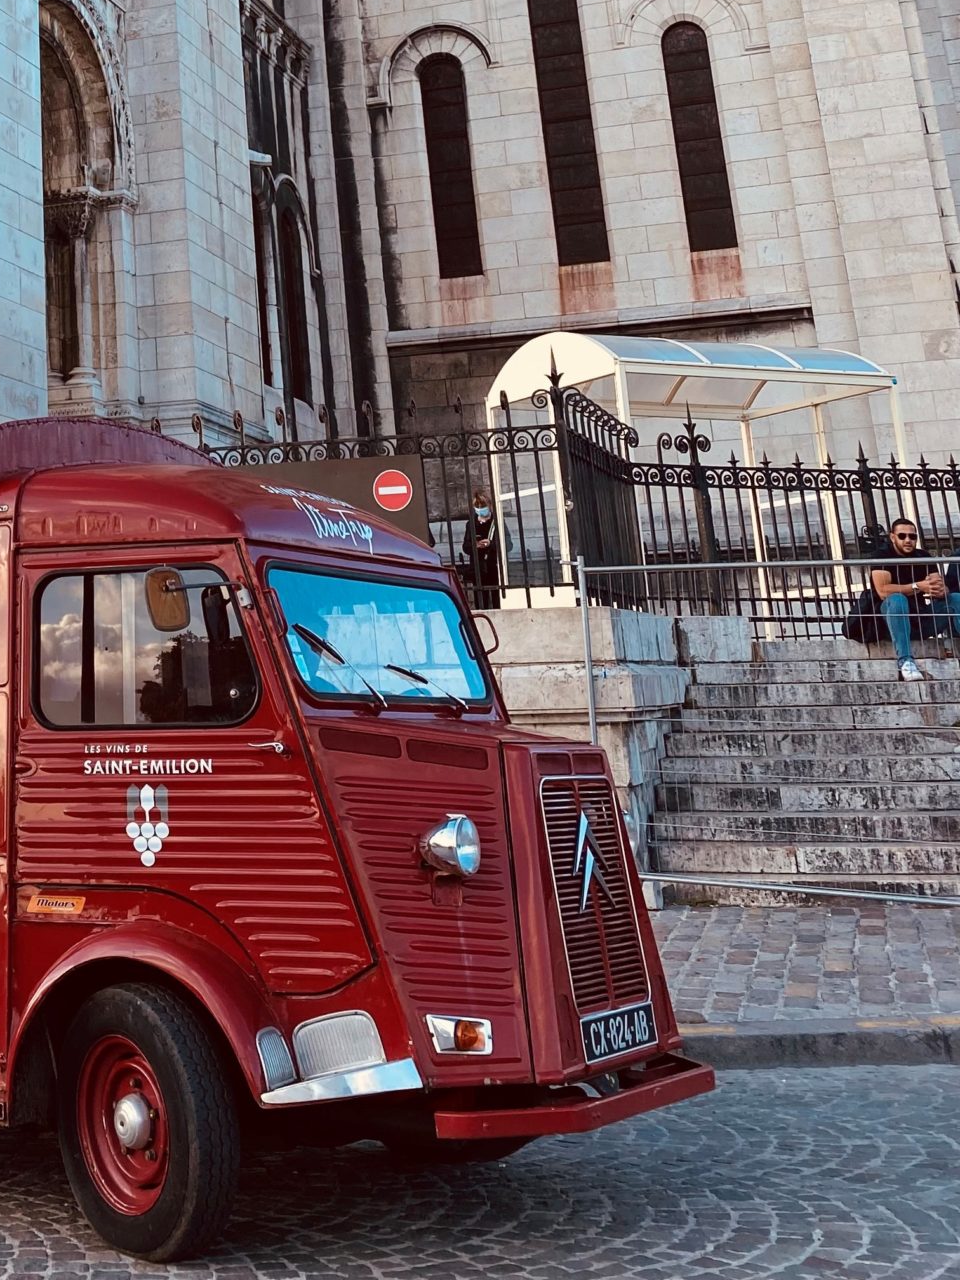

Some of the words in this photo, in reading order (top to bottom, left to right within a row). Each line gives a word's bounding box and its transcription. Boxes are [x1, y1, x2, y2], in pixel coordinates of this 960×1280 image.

[84, 744, 101, 754] LES
[106, 744, 130, 753] VINS
[134, 743, 148, 753] DE
[83, 758, 213, 775] SAINT-EMILION
